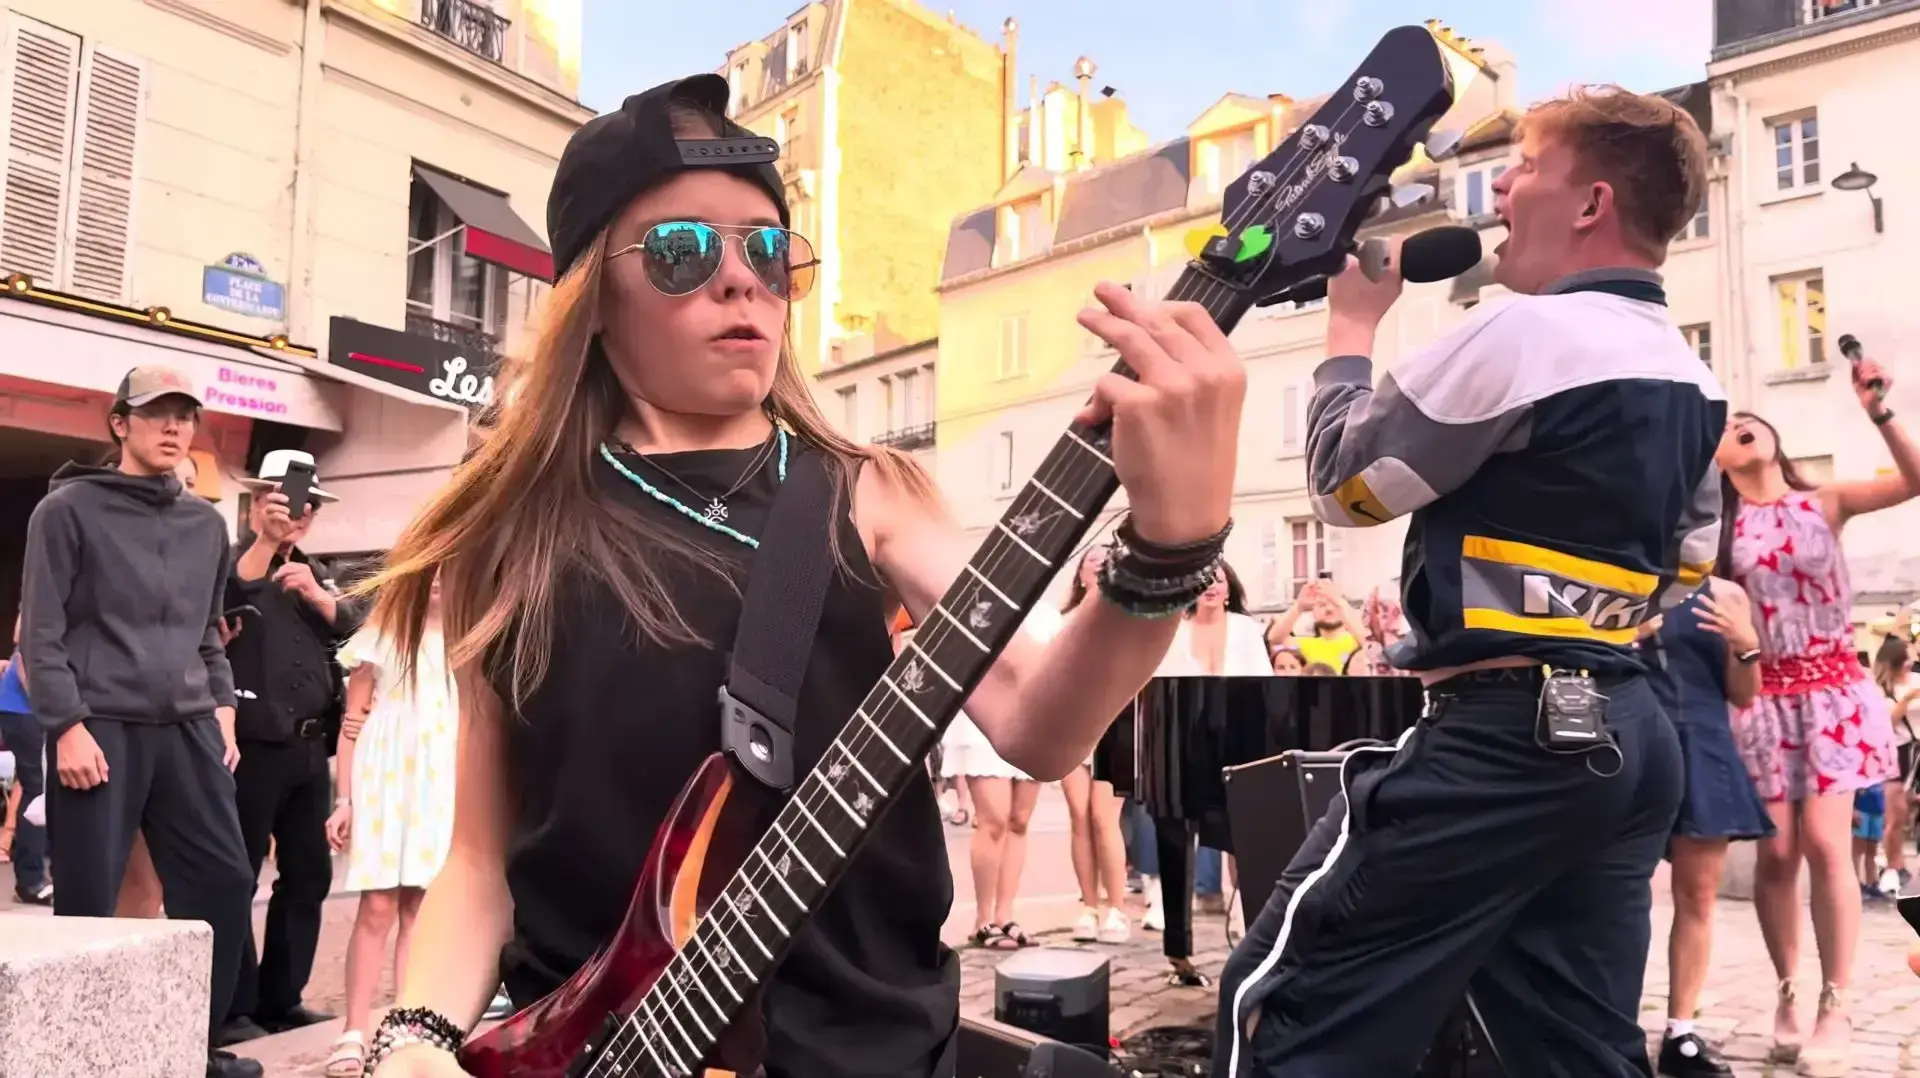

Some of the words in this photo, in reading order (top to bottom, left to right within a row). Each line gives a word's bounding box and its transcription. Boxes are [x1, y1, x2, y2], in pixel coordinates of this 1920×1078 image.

[229, 276, 262, 293] PLACE
[205, 387, 288, 413] Pression
[1523, 574, 1648, 629] NIK
